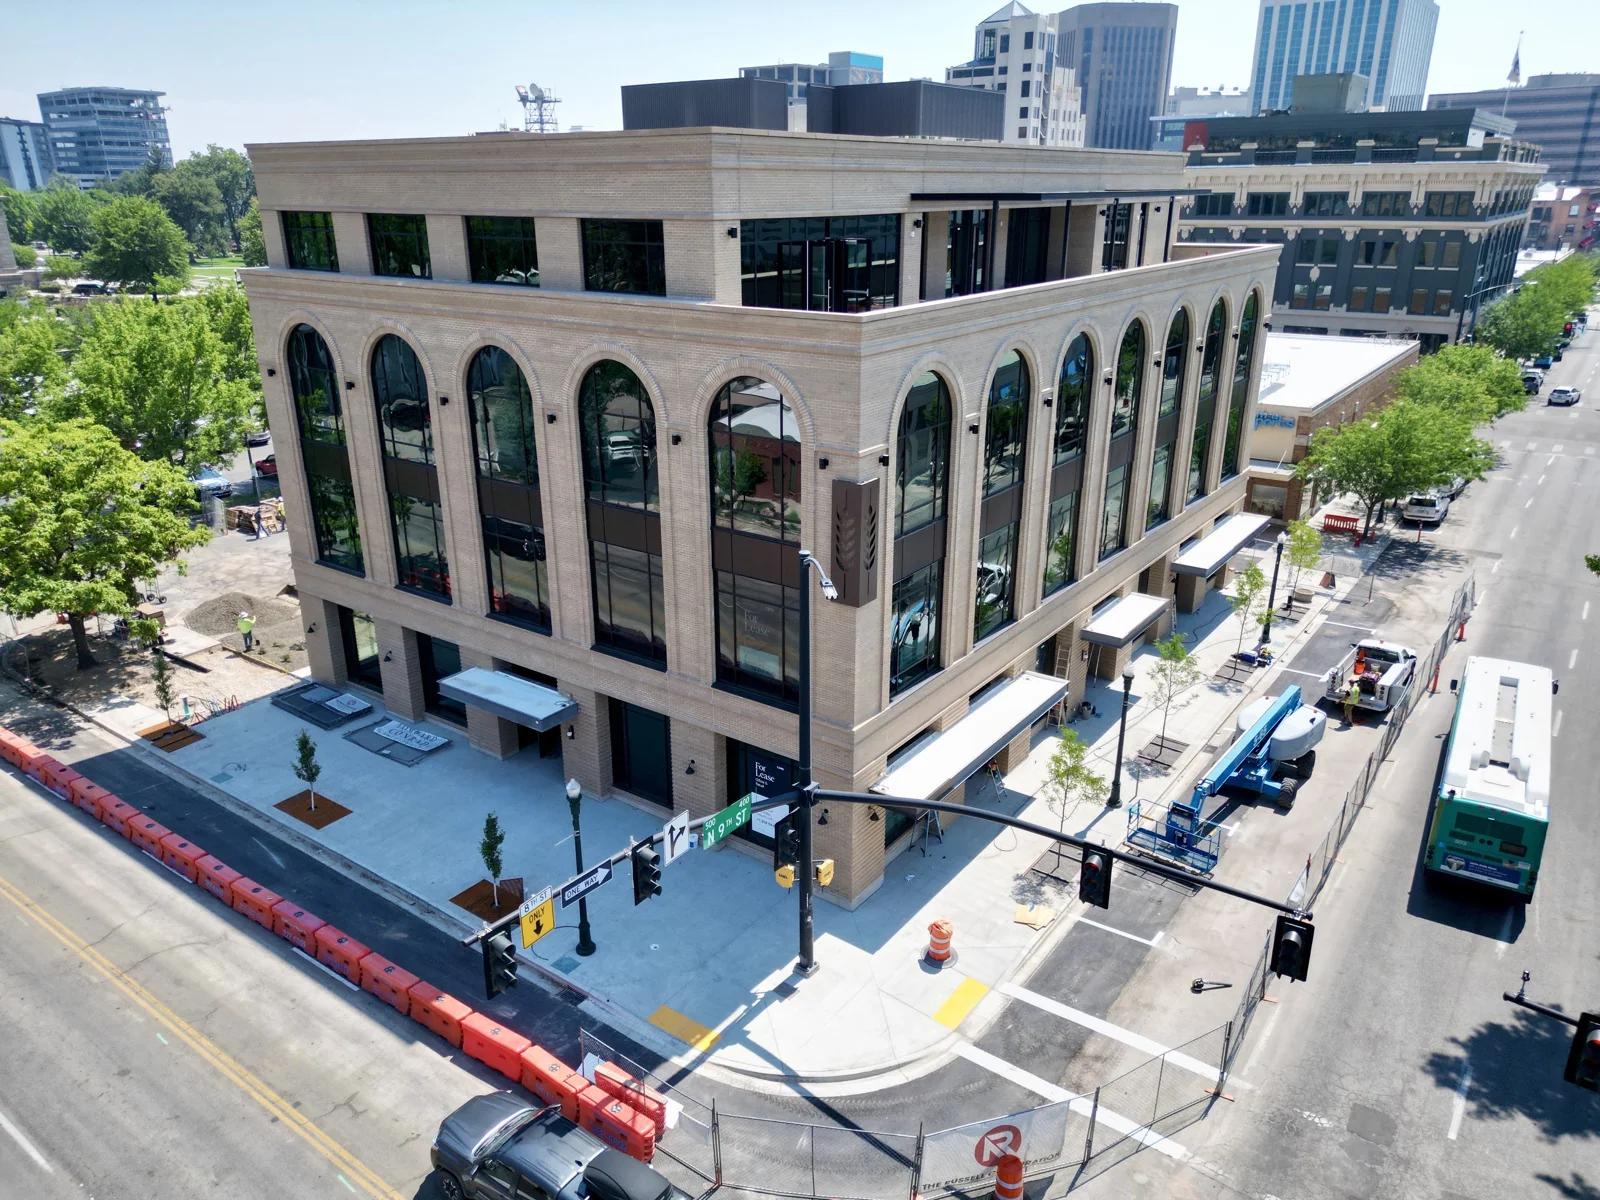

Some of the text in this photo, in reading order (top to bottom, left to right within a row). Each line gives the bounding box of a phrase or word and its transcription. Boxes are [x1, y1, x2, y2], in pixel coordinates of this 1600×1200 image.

[744, 610, 757, 623] For
[744, 620, 770, 637] Lease
[755, 761, 767, 772] For
[755, 769, 776, 783] Lease
[739, 796, 750, 808] 400
[705, 818, 716, 831] 500
[707, 829, 715, 846] N
[735, 808, 747, 827] ST
[566, 874, 598, 899] ONE WAY
[540, 891, 547, 902] ST
[528, 906, 546, 924] ONLY
[922, 1181, 942, 1191] THE
[944, 1172, 985, 1185] RUSSELL
